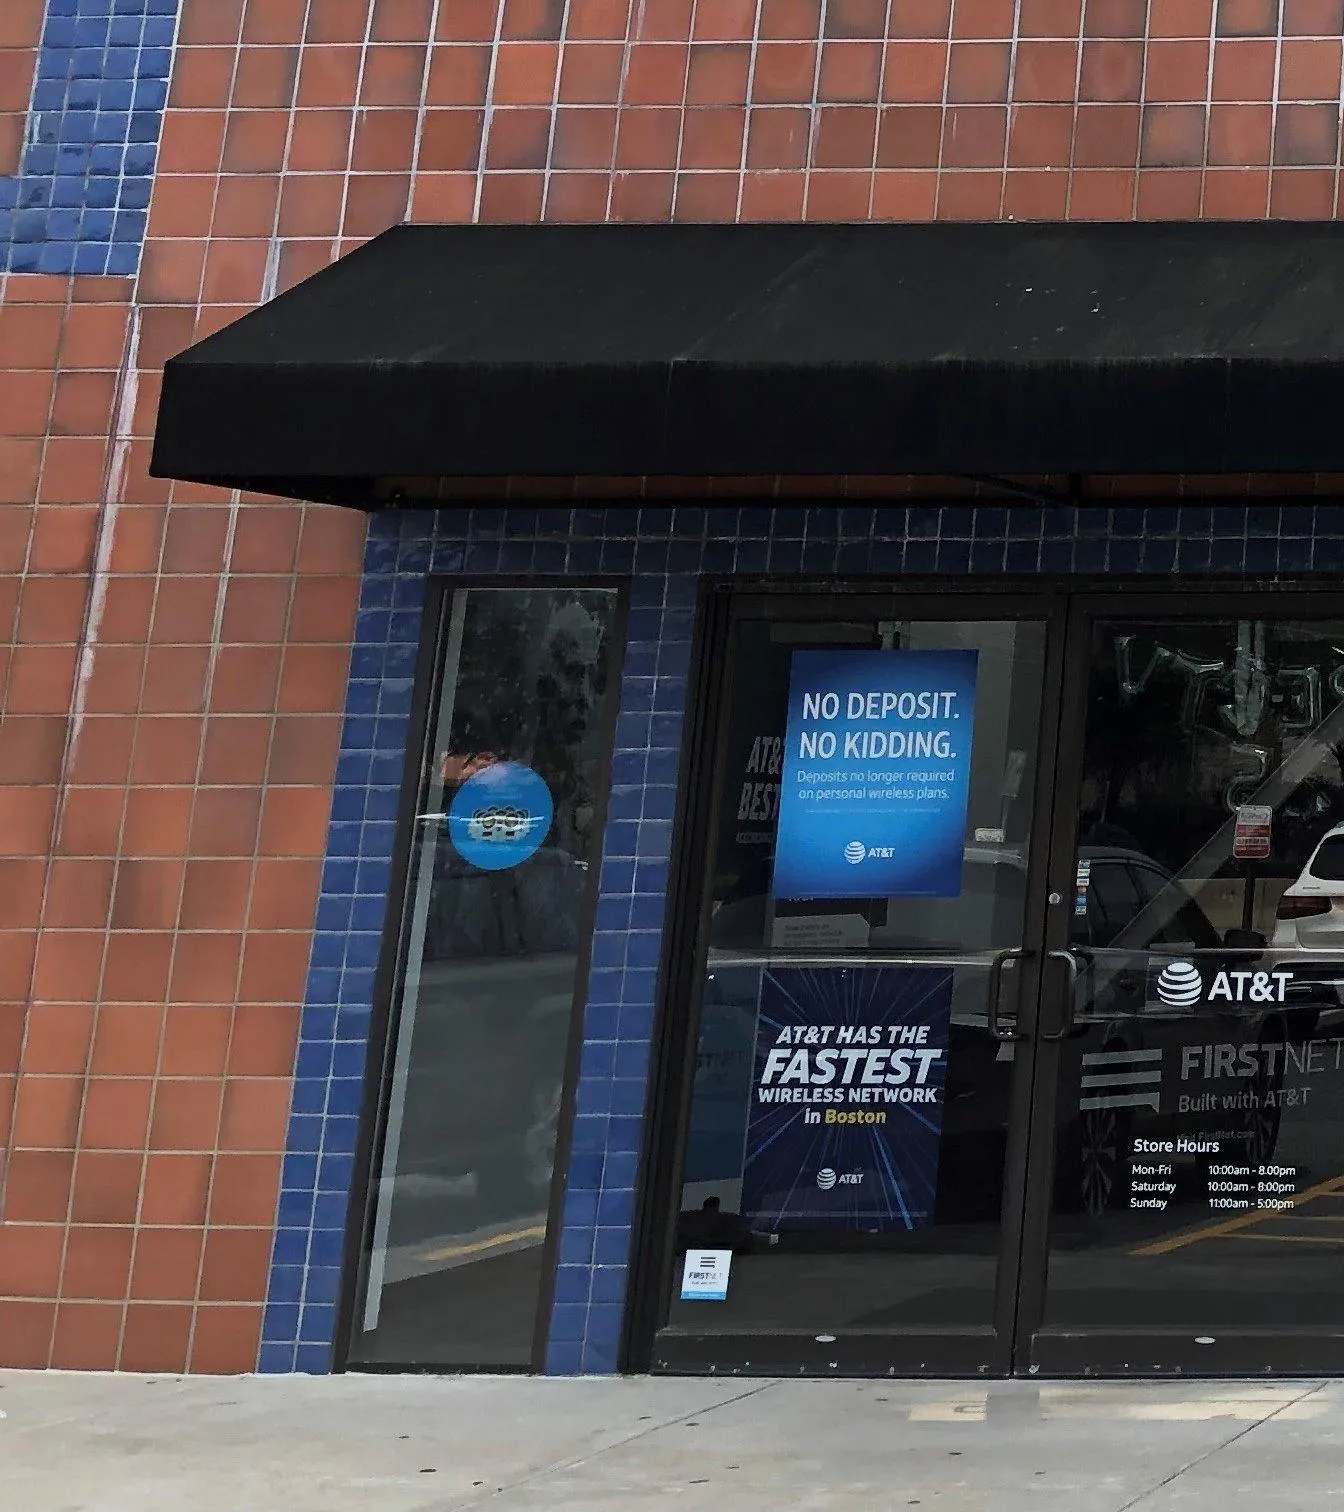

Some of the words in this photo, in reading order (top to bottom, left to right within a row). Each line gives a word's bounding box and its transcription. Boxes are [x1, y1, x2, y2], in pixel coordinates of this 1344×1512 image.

[802, 691, 840, 720] NO
[847, 691, 960, 720] DEPOSIT.
[799, 730, 837, 759] NO
[844, 730, 957, 759] KIDDING.
[797, 770, 848, 785] Deposits
[851, 772, 865, 782] no
[867, 769, 904, 785] longer
[906, 769, 955, 785] required
[798, 790, 814, 800] on
[815, 787, 866, 802] personal
[868, 787, 914, 800] wireless
[916, 786, 950, 802] plans.
[867, 847, 896, 858] AT&T
[1208, 971, 1294, 1003] AT&T
[776, 1025, 835, 1045] AT&T
[836, 1025, 883, 1045] HAS
[887, 1025, 931, 1045] THE
[760, 1048, 943, 1085] FASTEST
[758, 1087, 845, 1103] WIRELESS
[848, 1087, 938, 1103] NETWORK
[1178, 1092, 1218, 1113] Built
[1222, 1090, 1259, 1109] with
[1264, 1087, 1312, 1108] AT&T
[804, 1107, 821, 1124] in
[825, 1108, 887, 1125] Boston
[1133, 1139, 1174, 1153] Store
[1176, 1139, 1220, 1153] Hours
[1131, 1164, 1172, 1175] Mon-Fri
[1208, 1165, 1250, 1175] 10:00am
[838, 1173, 864, 1185] AT&T
[1131, 1181, 1177, 1194] Saturday
[1207, 1181, 1249, 1192] 10:00am
[1257, 1181, 1295, 1194] 8:00pm
[1130, 1197, 1168, 1210] Sunday
[1209, 1198, 1249, 1209] 11:00am
[1257, 1198, 1294, 1210] 5:00pm
